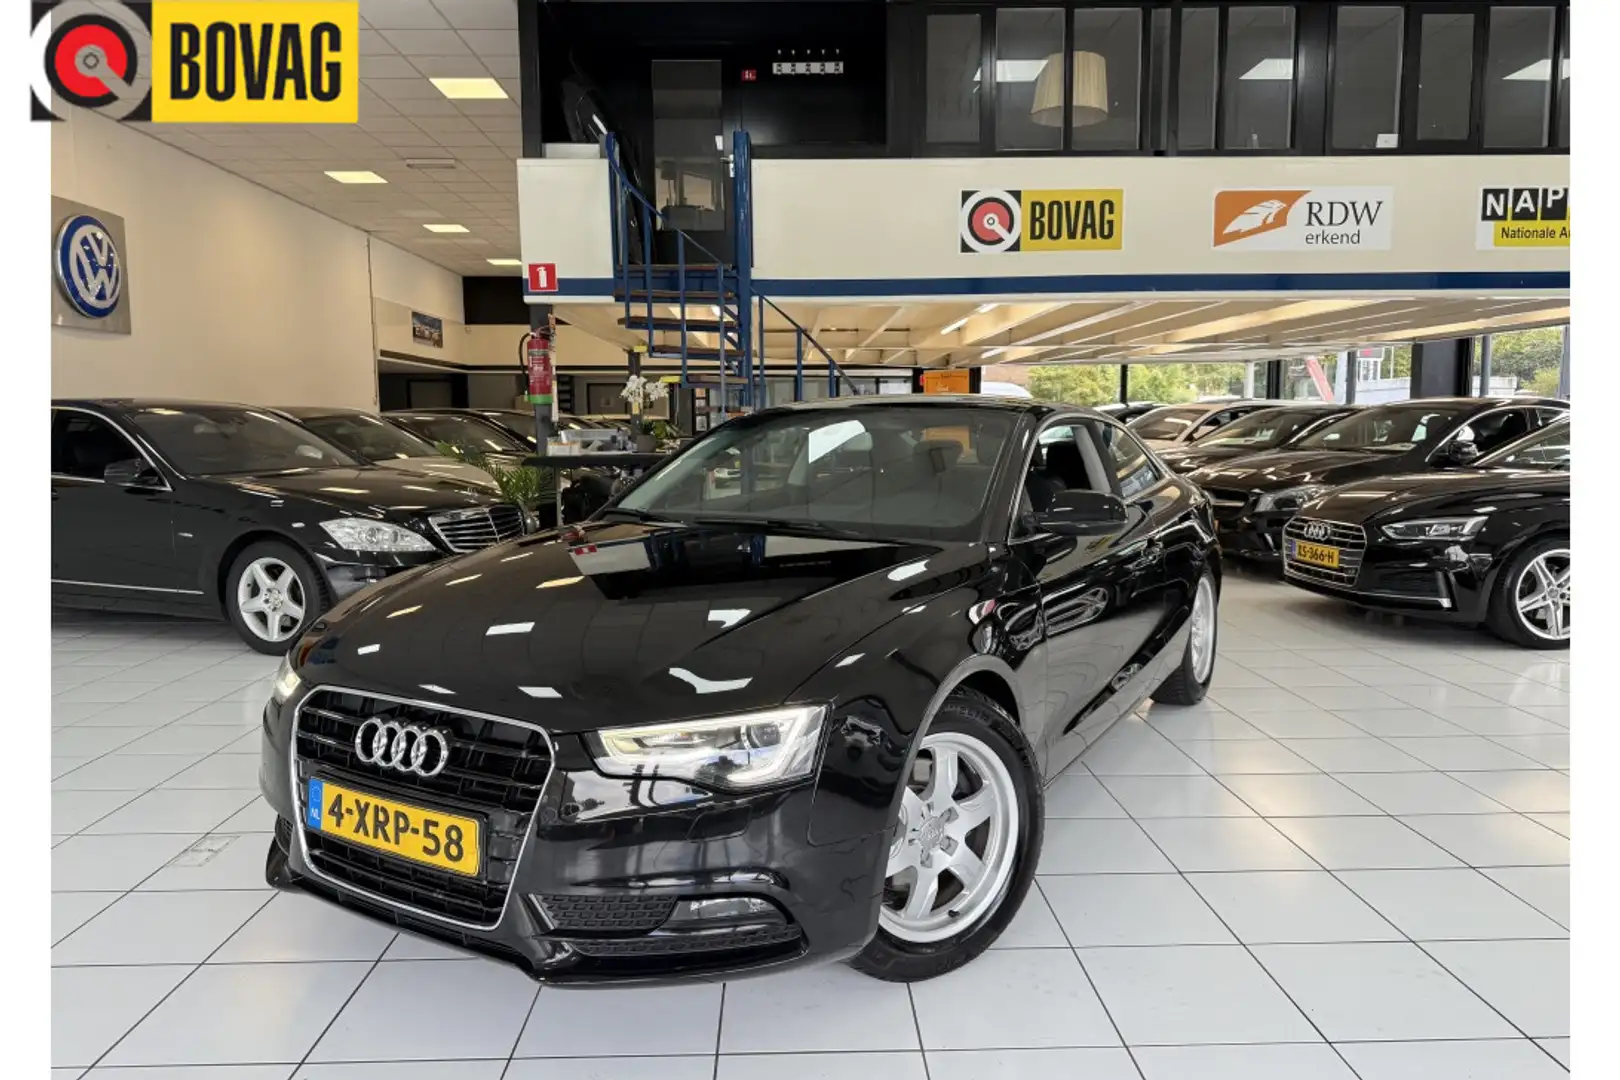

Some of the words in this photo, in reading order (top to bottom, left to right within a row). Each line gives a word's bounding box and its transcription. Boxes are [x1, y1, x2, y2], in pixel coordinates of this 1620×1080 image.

[1305, 201, 1384, 227] RDW
[1486, 186, 1565, 216] NAP
[1030, 199, 1115, 241] BOVAG
[1501, 226, 1556, 239] Nationale
[1559, 226, 1570, 239] A
[1305, 229, 1361, 245] erkend
[310, 807, 320, 820] NL
[328, 793, 465, 862] 4-XRP-58
